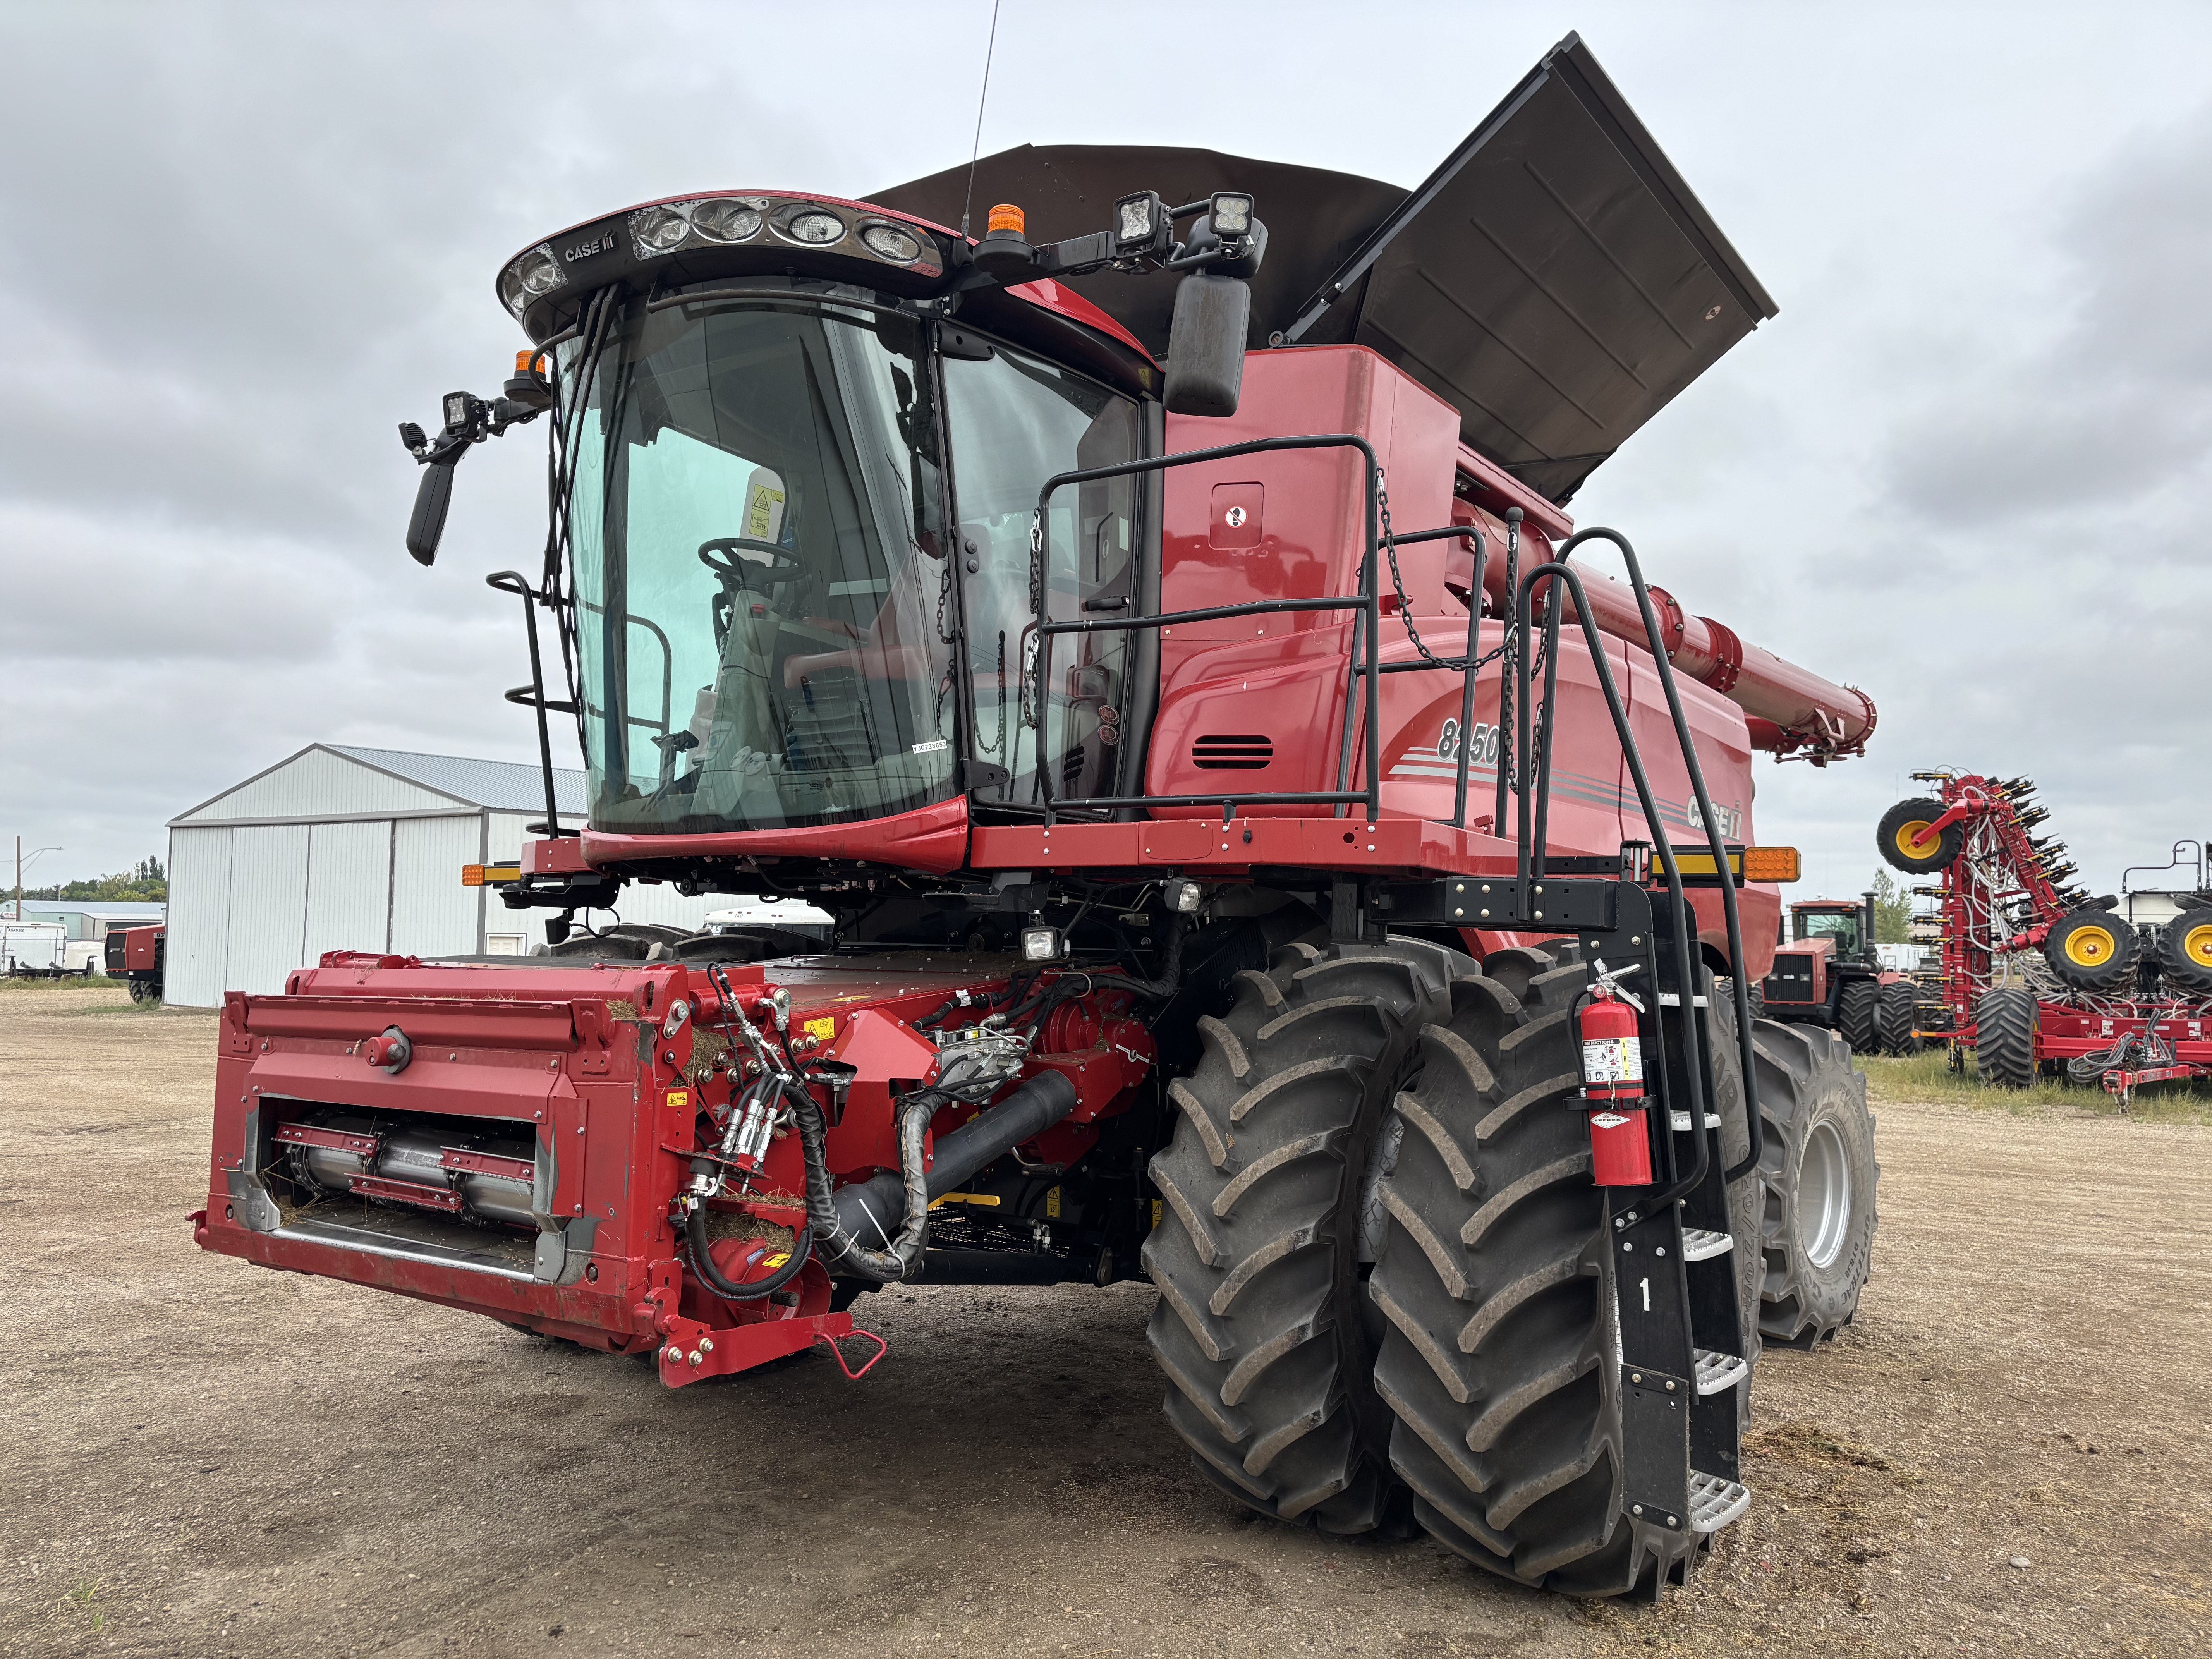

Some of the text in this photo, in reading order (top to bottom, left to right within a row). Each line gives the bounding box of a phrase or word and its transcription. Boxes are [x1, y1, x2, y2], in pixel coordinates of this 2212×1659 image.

[565, 241, 600, 262] CASE
[913, 742, 946, 751] YJG238653
[1841, 1214, 1870, 1305] OPTITRAC
[1640, 1278, 1650, 1311] 1
